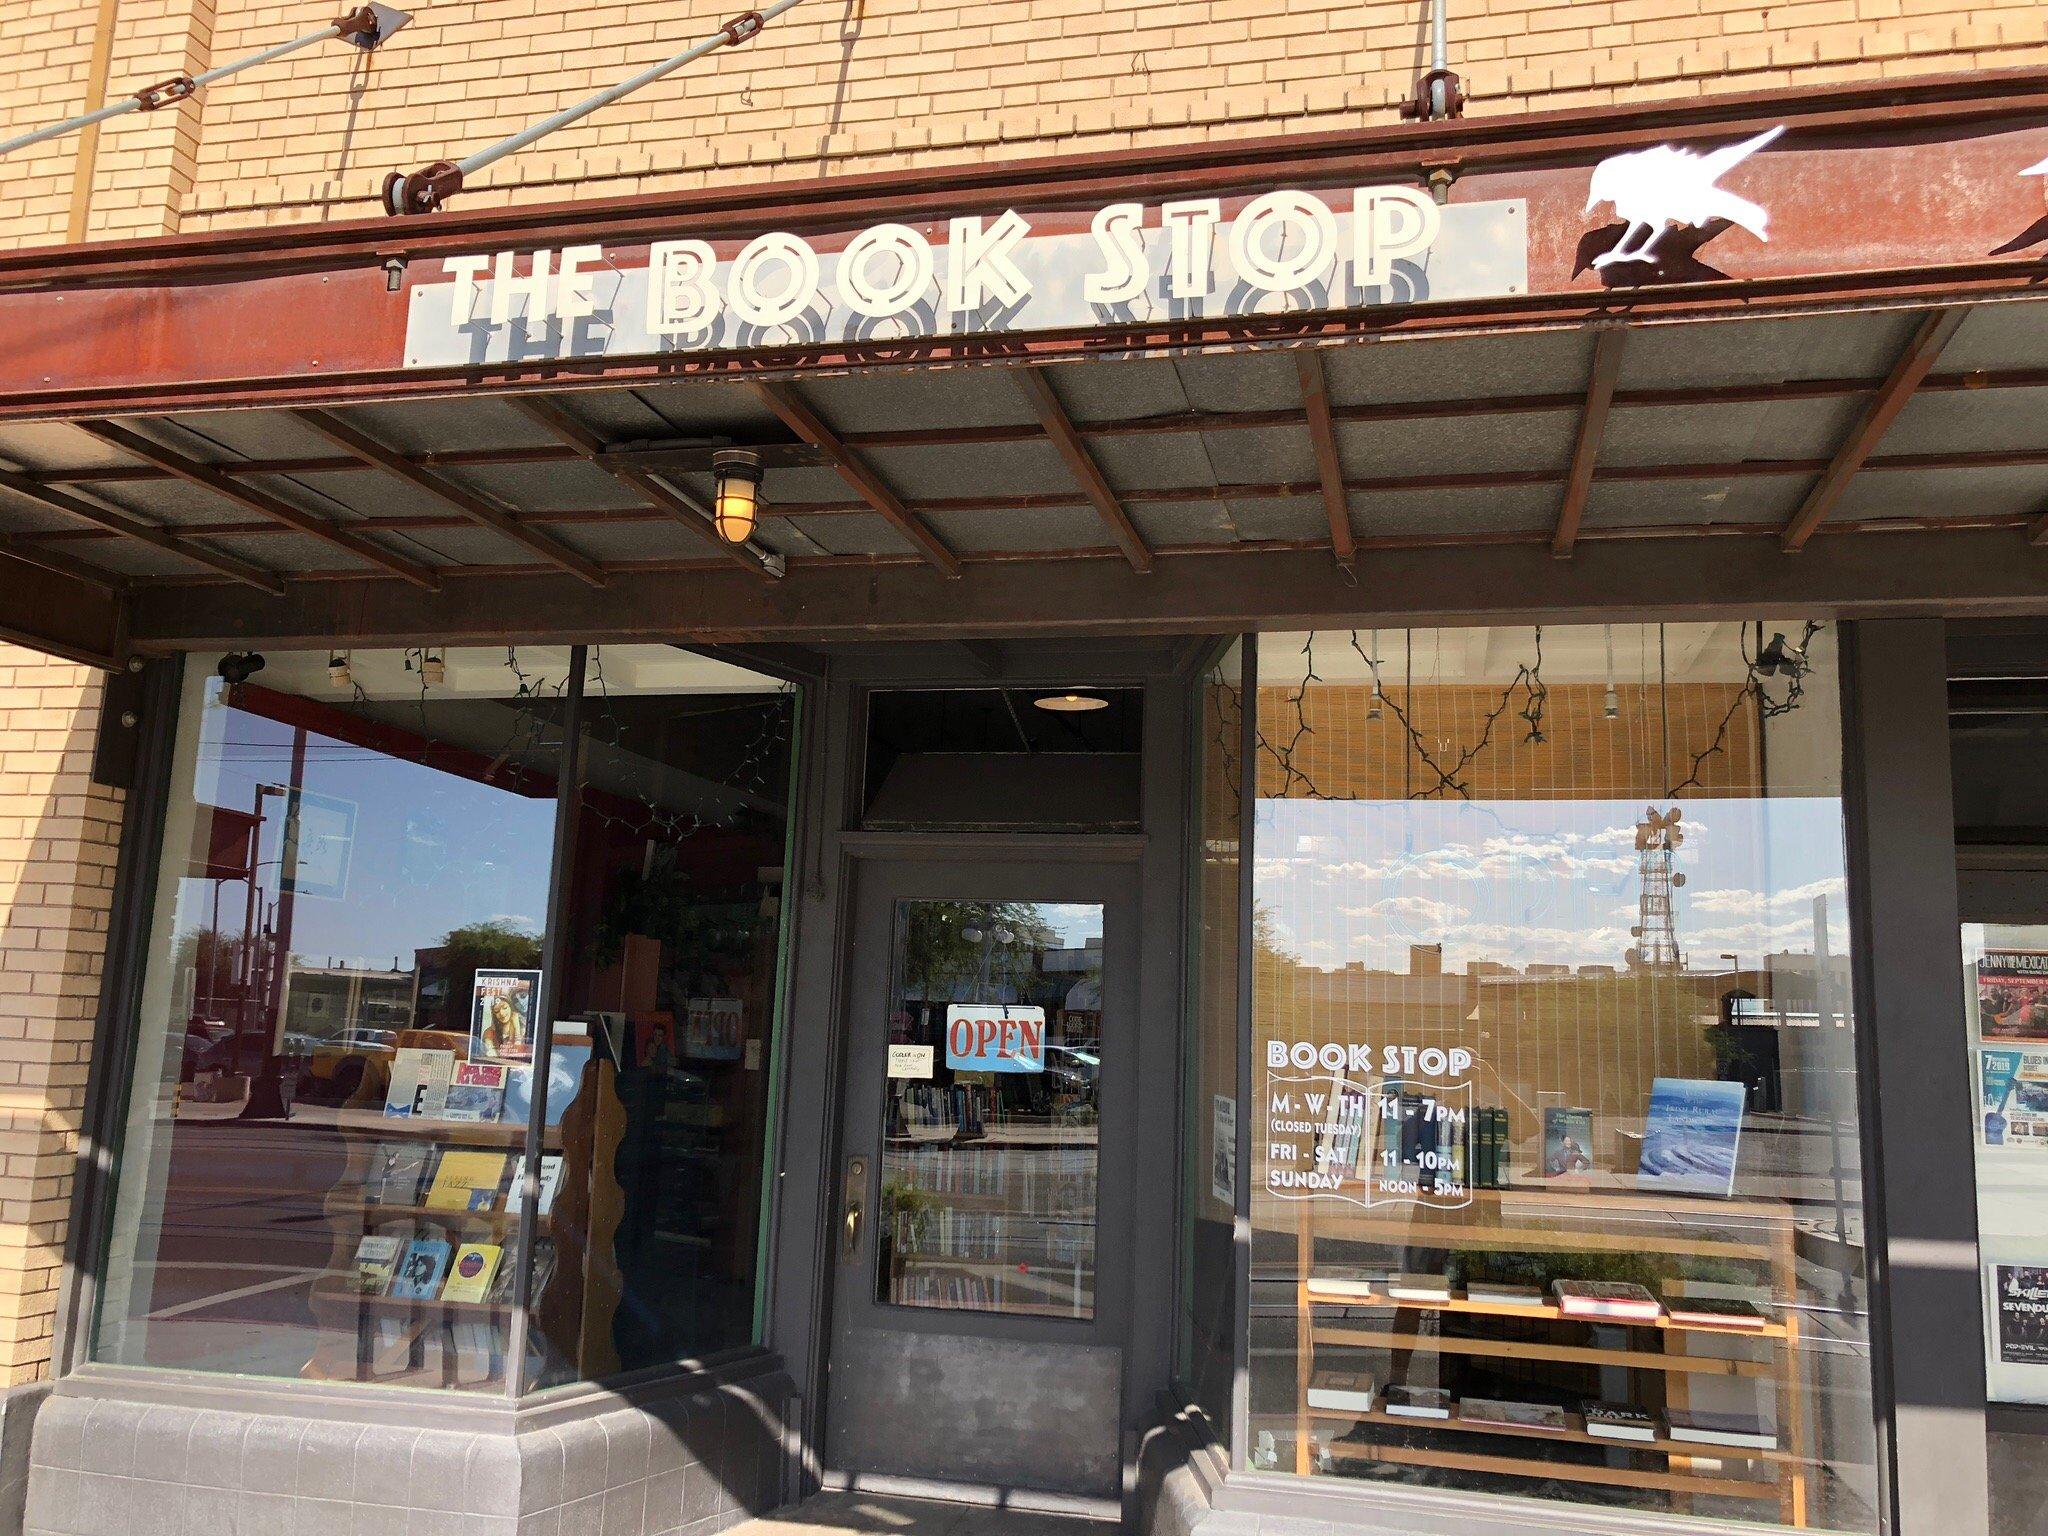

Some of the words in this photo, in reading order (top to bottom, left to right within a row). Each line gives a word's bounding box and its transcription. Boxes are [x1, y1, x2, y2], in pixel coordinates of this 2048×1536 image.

[442, 244, 604, 326] THE
[645, 207, 1033, 335] BOOK
[1084, 184, 1441, 304] STOP
[480, 987, 502, 996] FEST
[481, 977, 518, 987] KRISHNA
[2007, 977, 2044, 986] SEPTEMBER
[949, 1018, 1043, 1060] OPEN
[1267, 1040, 1373, 1073] BOOK
[1382, 1045, 1472, 1077] STOP
[1271, 1092, 1290, 1114] M
[1304, 1093, 1325, 1116] W
[1338, 1094, 1364, 1118] TH
[1378, 1096, 1399, 1120] 11
[1421, 1098, 1466, 1123] 7PM
[1270, 1118, 1312, 1135] (CLOSED
[1314, 1122, 1362, 1137] TUESDAY)
[1270, 1143, 1297, 1161] FRI
[1315, 1146, 1347, 1164] SAT
[1380, 1149, 1397, 1167] 11
[1416, 1151, 1460, 1171] 10PM
[1270, 1169, 1343, 1191] SUNDAY
[1379, 1180, 1417, 1194] NOON
[1433, 1178, 1464, 1197] 5PM
